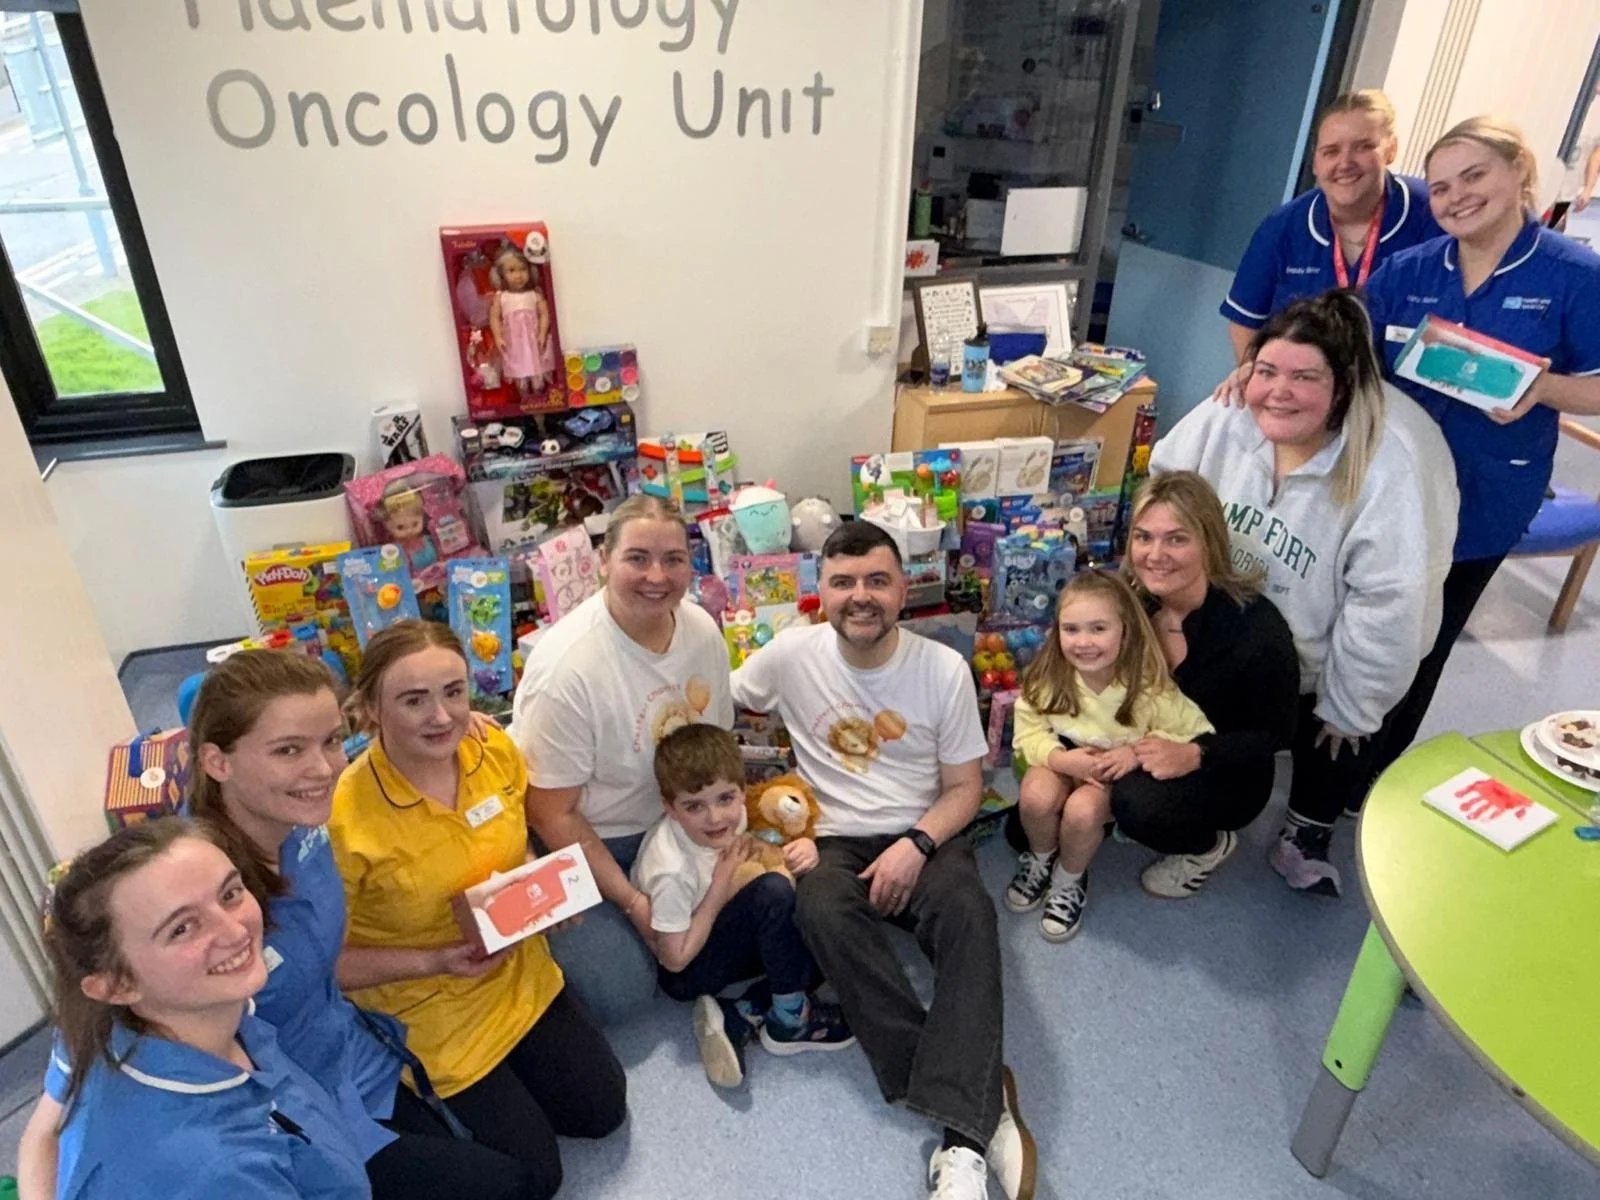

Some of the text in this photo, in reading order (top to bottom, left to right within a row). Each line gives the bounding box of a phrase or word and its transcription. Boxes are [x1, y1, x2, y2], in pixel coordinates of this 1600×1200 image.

[206, 53, 835, 167] Oncology Unit
[1221, 502, 1317, 579] MP FORT
